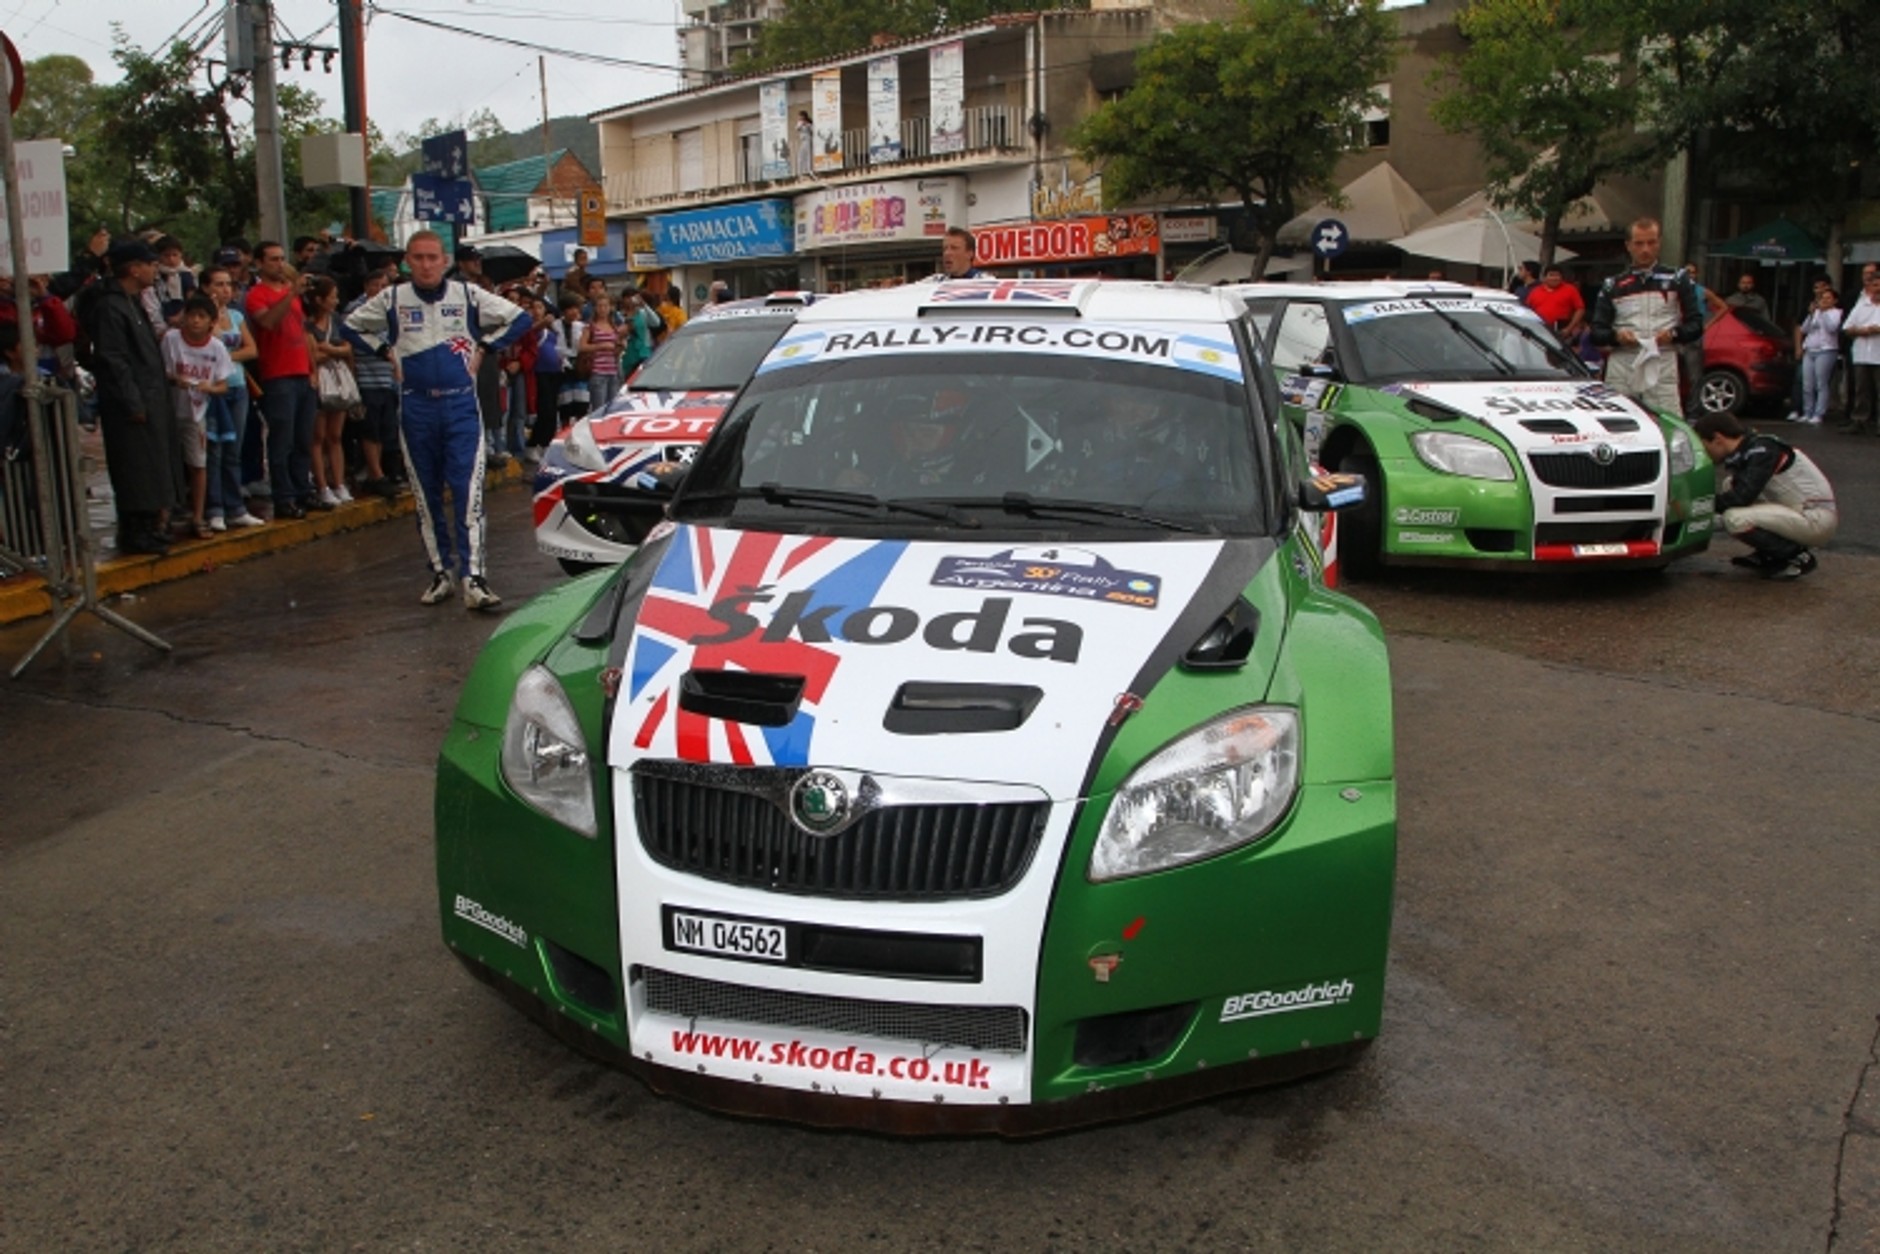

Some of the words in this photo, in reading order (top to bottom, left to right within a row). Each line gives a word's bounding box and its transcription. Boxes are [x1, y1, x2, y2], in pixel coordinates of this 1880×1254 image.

[824, 184, 886, 201] LIBRERIA
[668, 215, 759, 244] FARMACIA
[974, 223, 1089, 262] OMEDOR
[689, 240, 747, 260] AVENIDA
[824, 323, 1170, 358] RALLY-IRC.COM
[1484, 396, 1628, 415] Škoda
[1041, 549, 1059, 560] 4
[936, 573, 1097, 597] Argentina
[1060, 570, 1121, 588] Rally
[1104, 591, 1155, 606] 2010
[687, 584, 1085, 664] Škoda
[455, 893, 528, 945] BFGoodrich
[675, 915, 703, 946] NM
[712, 925, 783, 957] 04562
[1220, 978, 1355, 1015] BFGoodrich
[671, 1030, 991, 1090] www.skoda.co.uk
